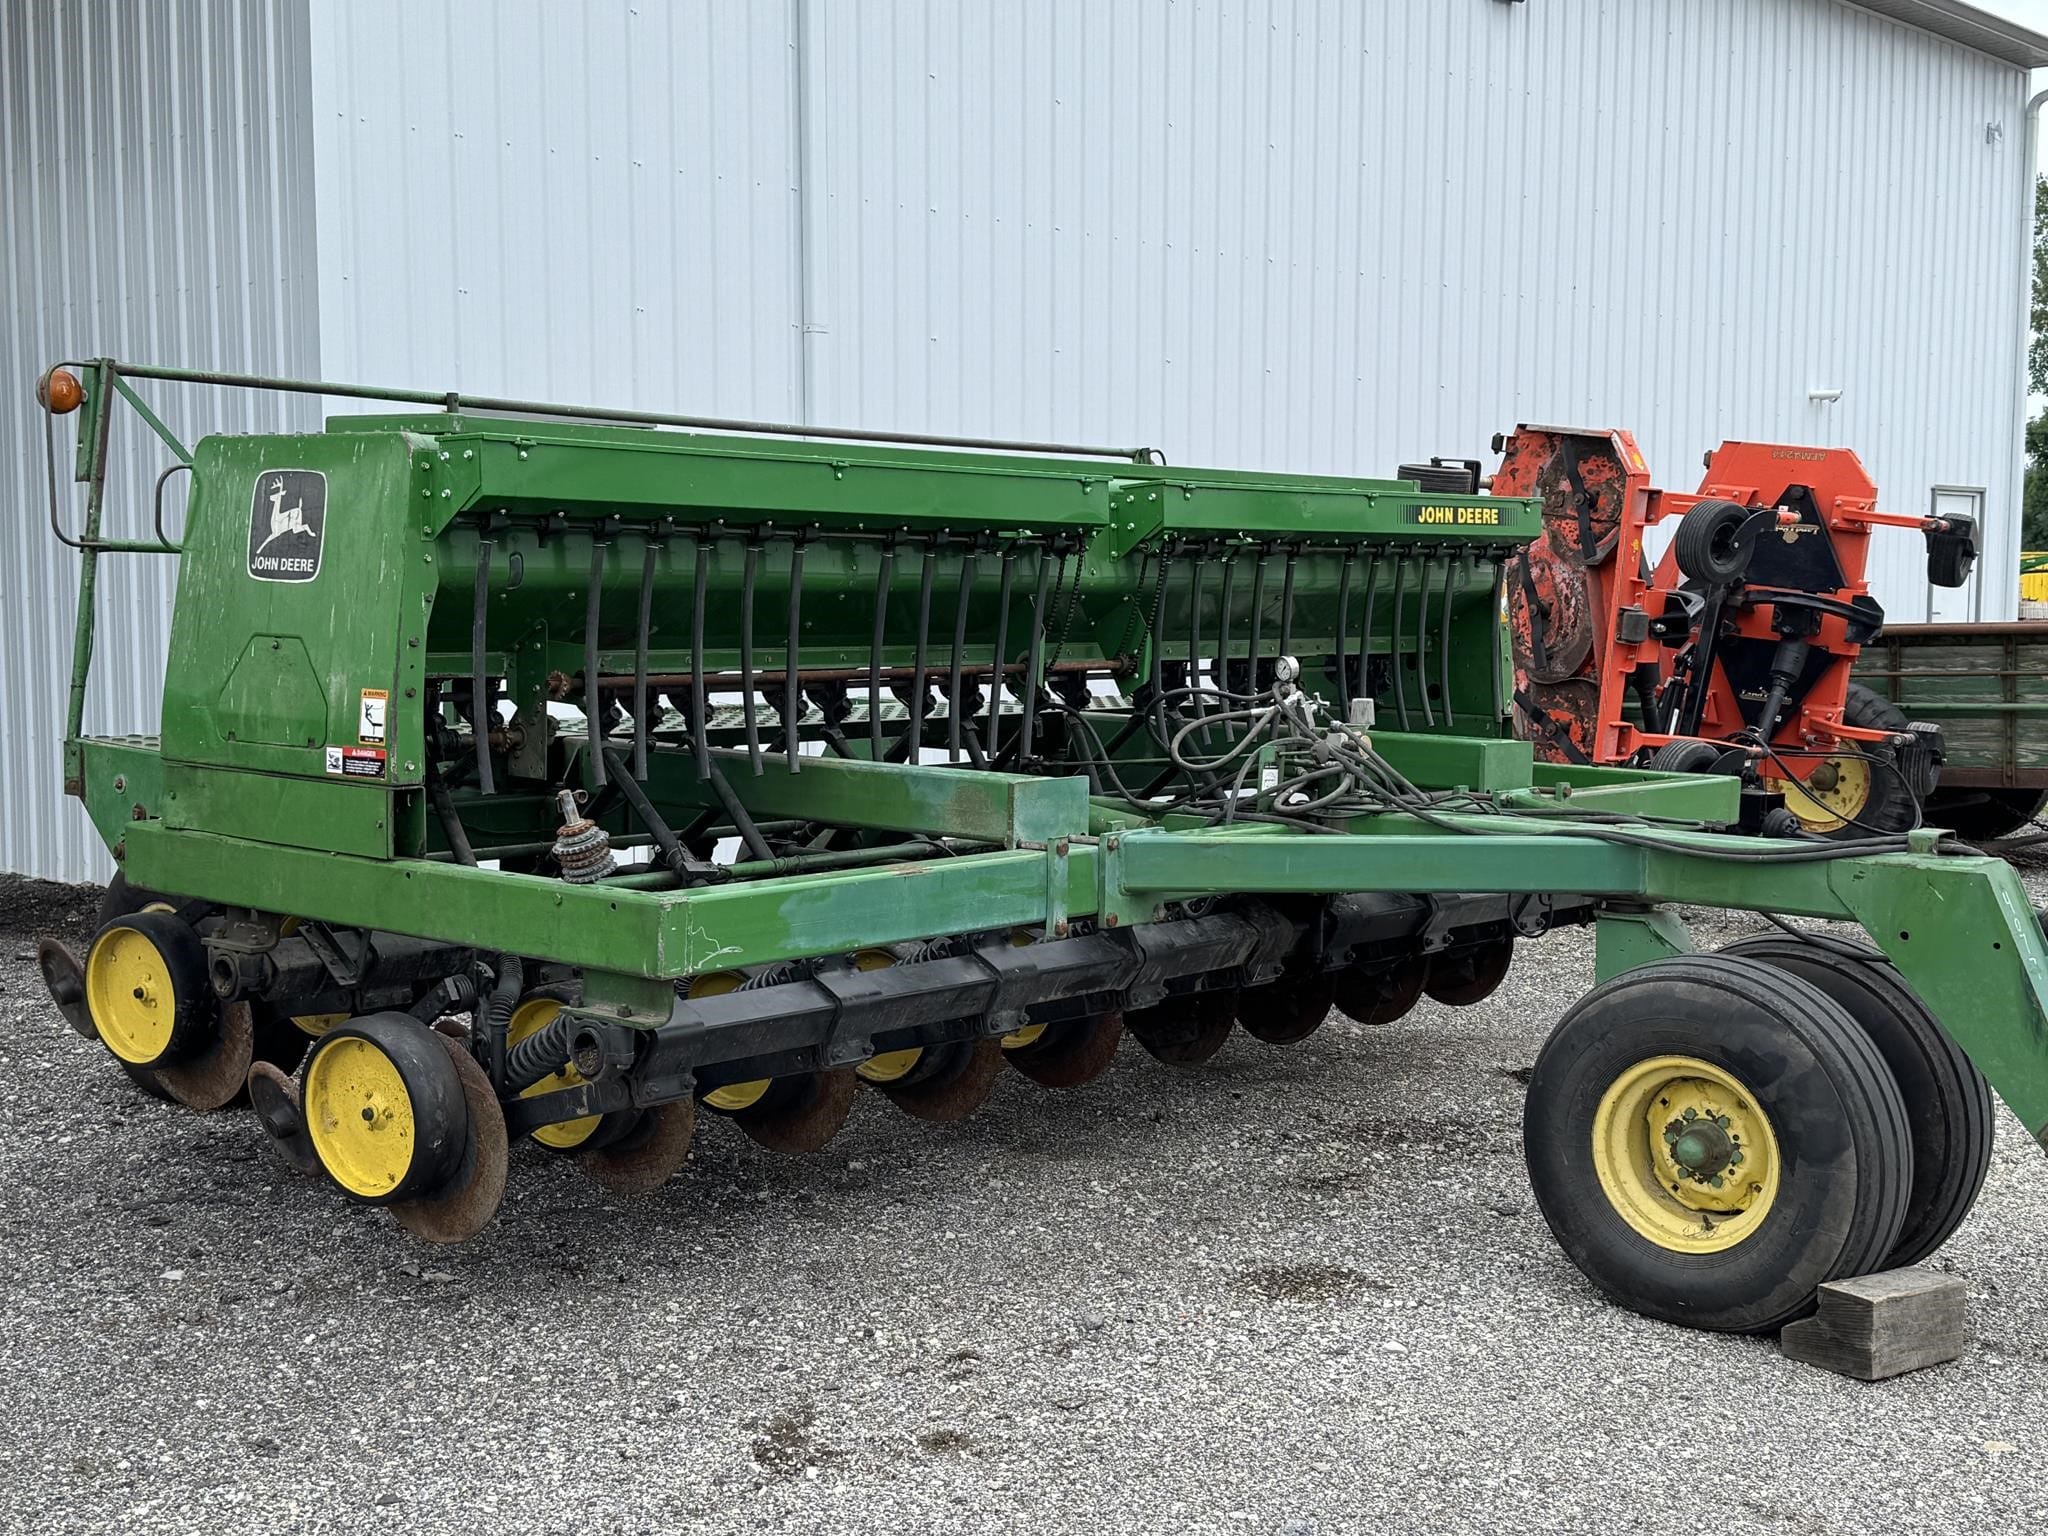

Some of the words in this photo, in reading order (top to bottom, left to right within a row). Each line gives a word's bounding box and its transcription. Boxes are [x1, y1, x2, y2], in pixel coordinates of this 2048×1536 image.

[1418, 507, 1453, 523] JOHN
[1458, 508, 1498, 524] DEERE
[251, 556, 279, 571] JOHN
[280, 558, 314, 572] DEERE
